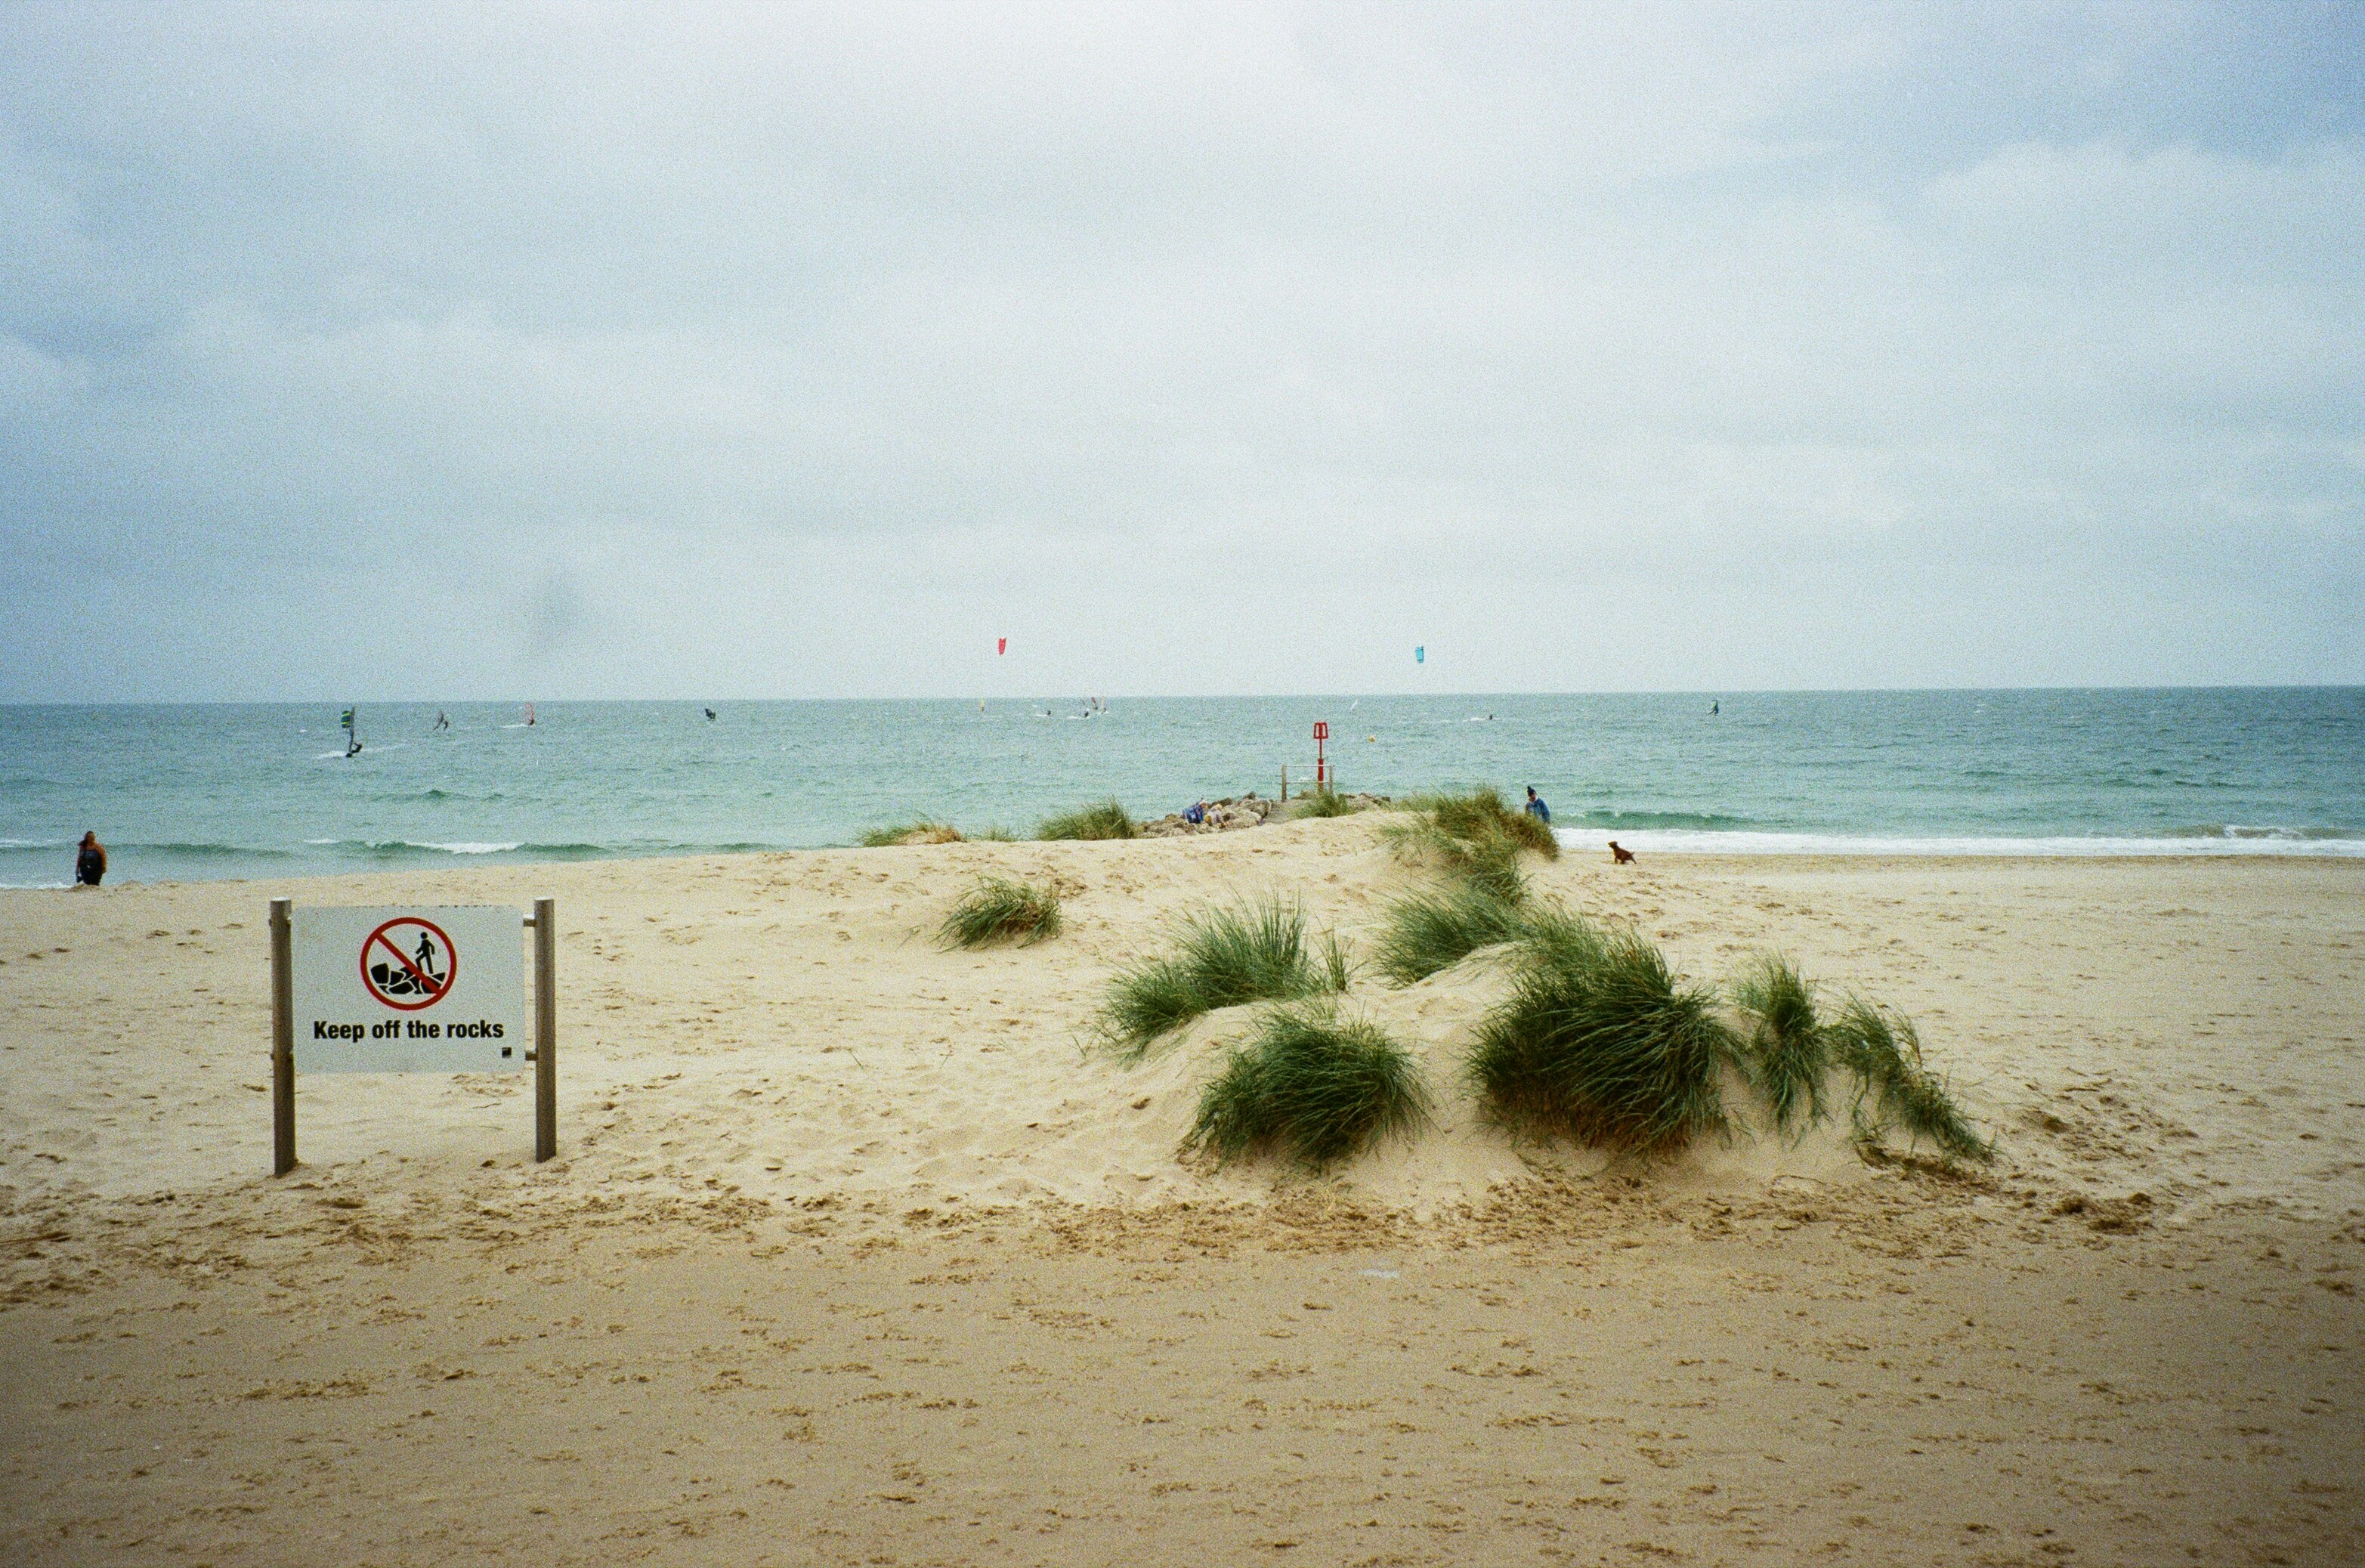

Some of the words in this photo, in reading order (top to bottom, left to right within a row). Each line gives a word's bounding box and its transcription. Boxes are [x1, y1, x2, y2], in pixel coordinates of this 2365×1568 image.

[314, 1021, 364, 1043] Keep
[372, 1020, 400, 1039] off
[407, 1020, 441, 1038] the
[447, 1020, 504, 1038] rocks
